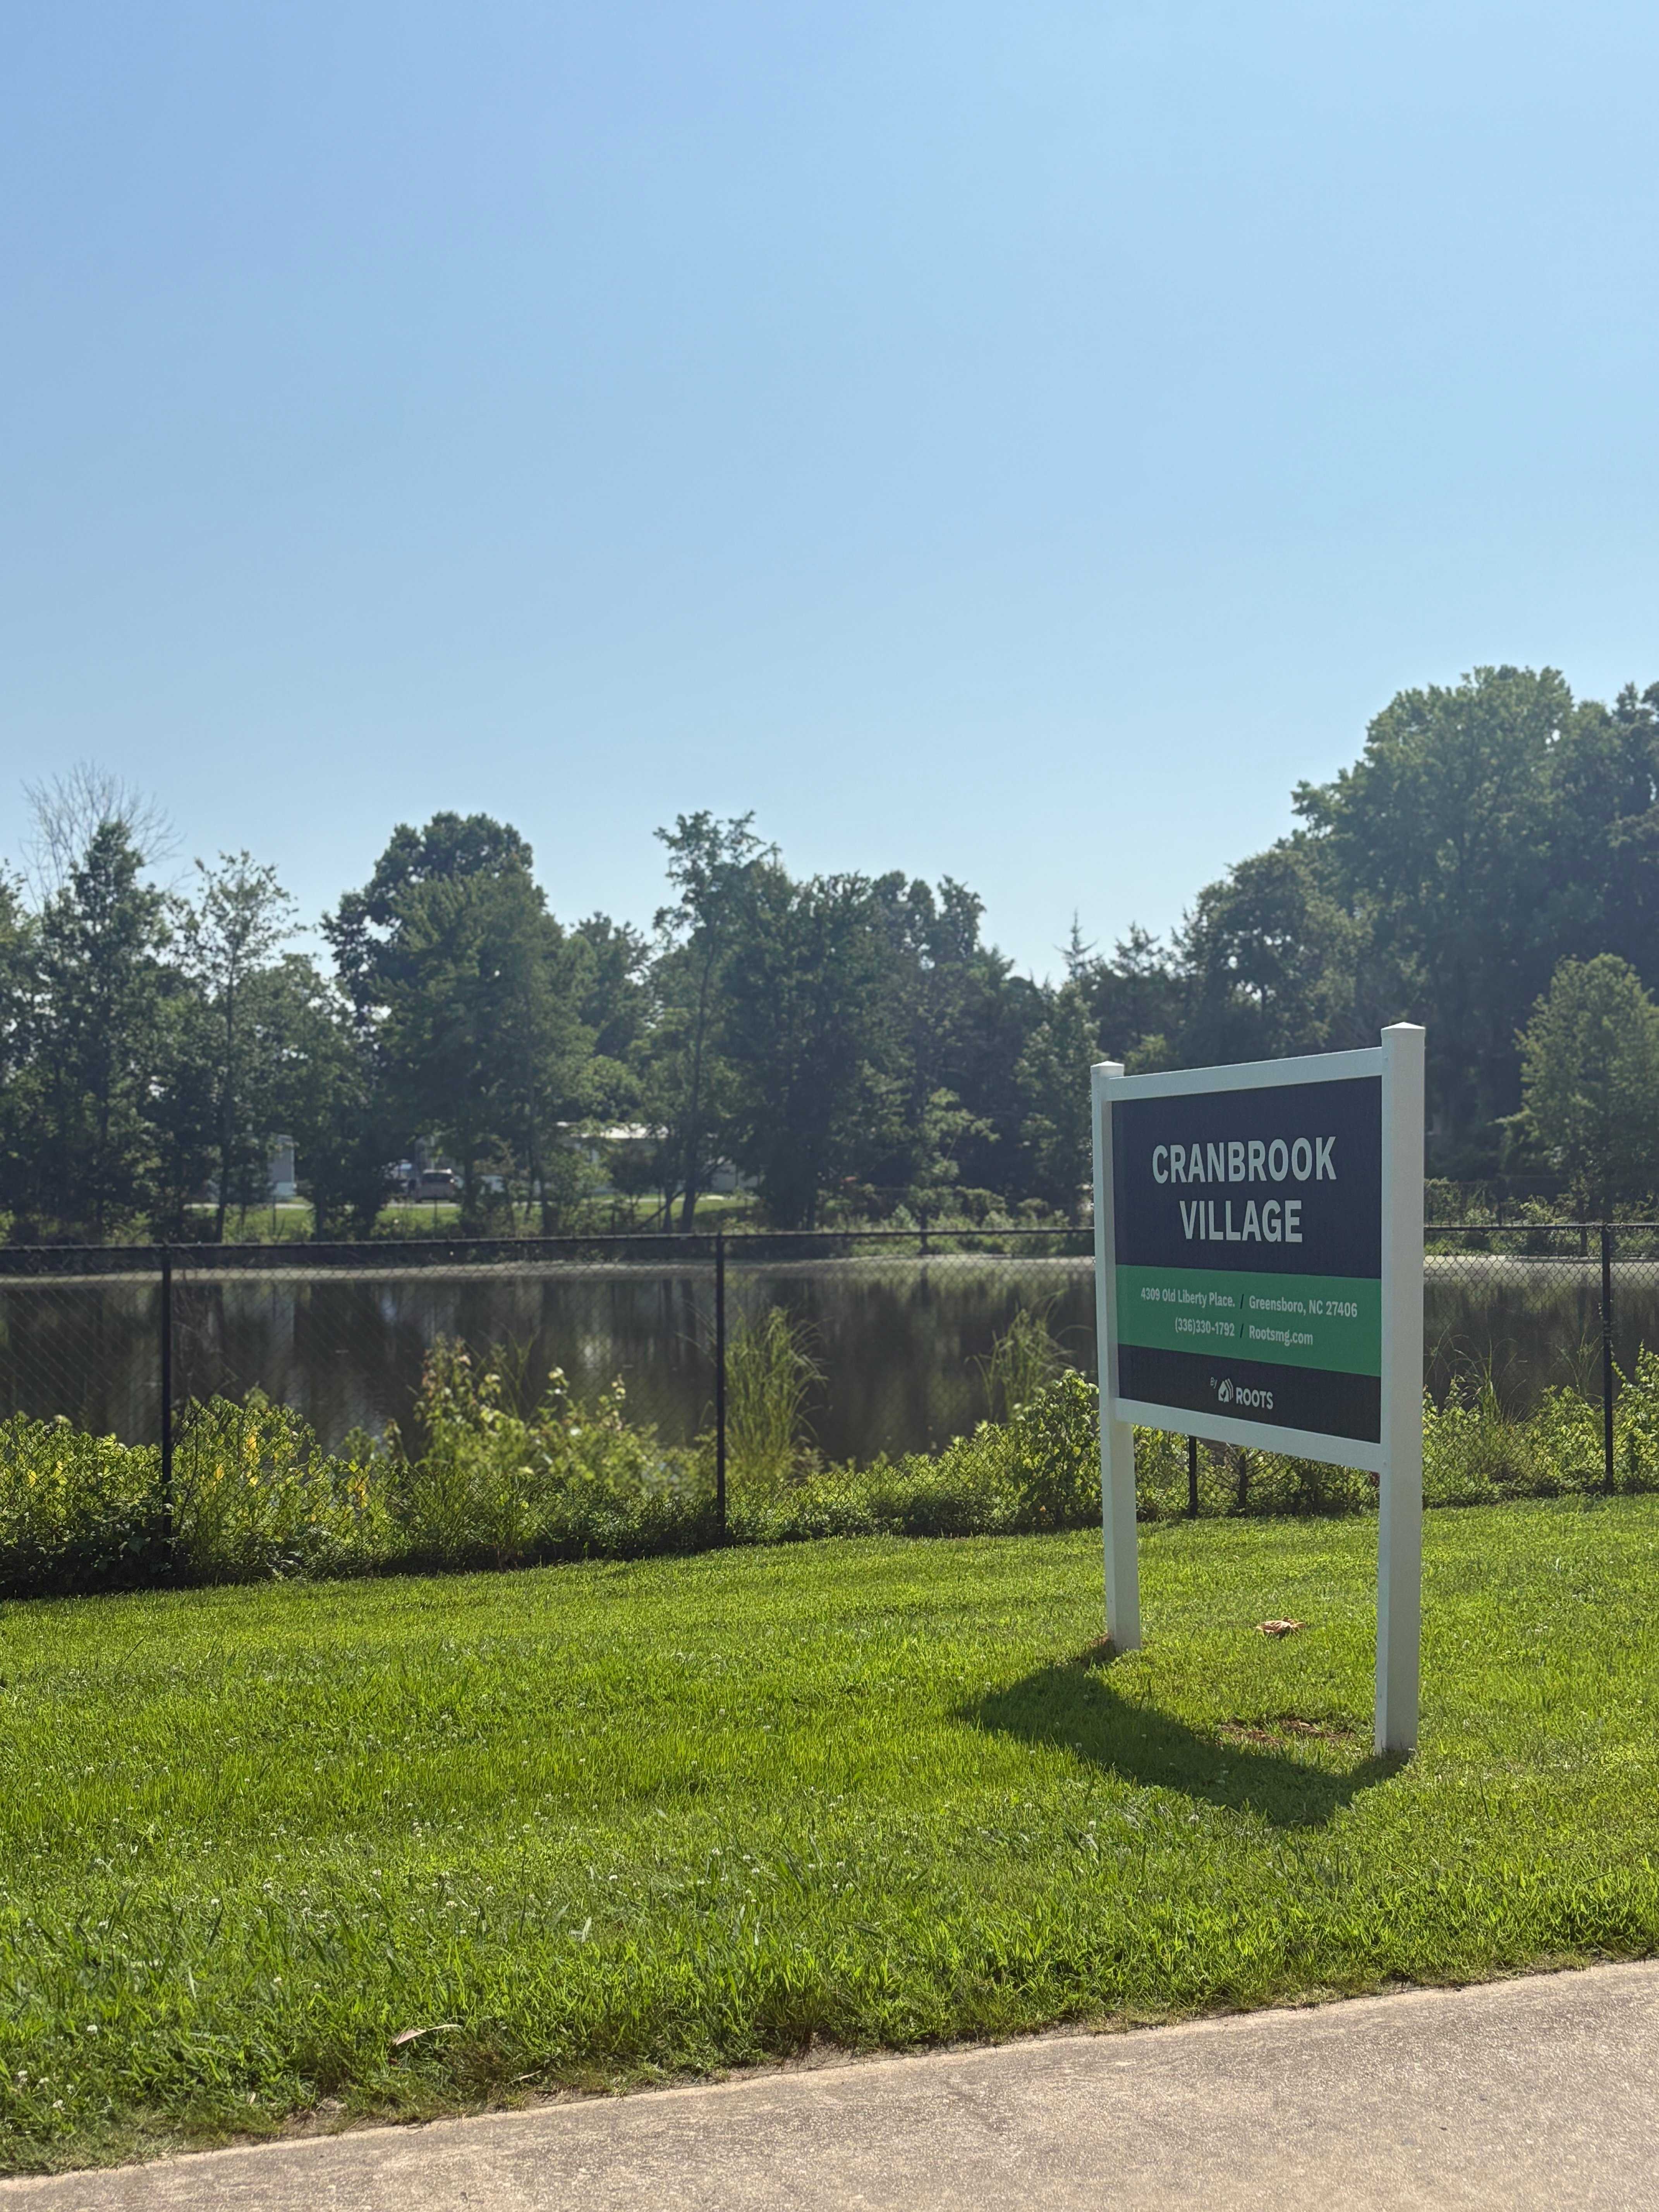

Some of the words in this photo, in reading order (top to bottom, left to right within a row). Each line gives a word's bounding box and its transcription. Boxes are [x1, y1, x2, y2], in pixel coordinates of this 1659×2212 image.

[1152, 1136, 1337, 1184] CRANBROOK
[1179, 1200, 1303, 1243] VILLAGE
[1140, 1287, 1160, 1301] 4309
[1162, 1288, 1176, 1302] Old
[1178, 1289, 1207, 1308] Liberty
[1209, 1292, 1235, 1307] Place.
[1249, 1295, 1306, 1316] Greensboro,
[1309, 1300, 1323, 1314] NC
[1326, 1301, 1357, 1317] 27406
[1175, 1317, 1235, 1337] (336)330-1792
[1249, 1325, 1313, 1346] Rootsmg.com
[1210, 1377, 1218, 1389] By
[1236, 1387, 1273, 1410] ROOTS
